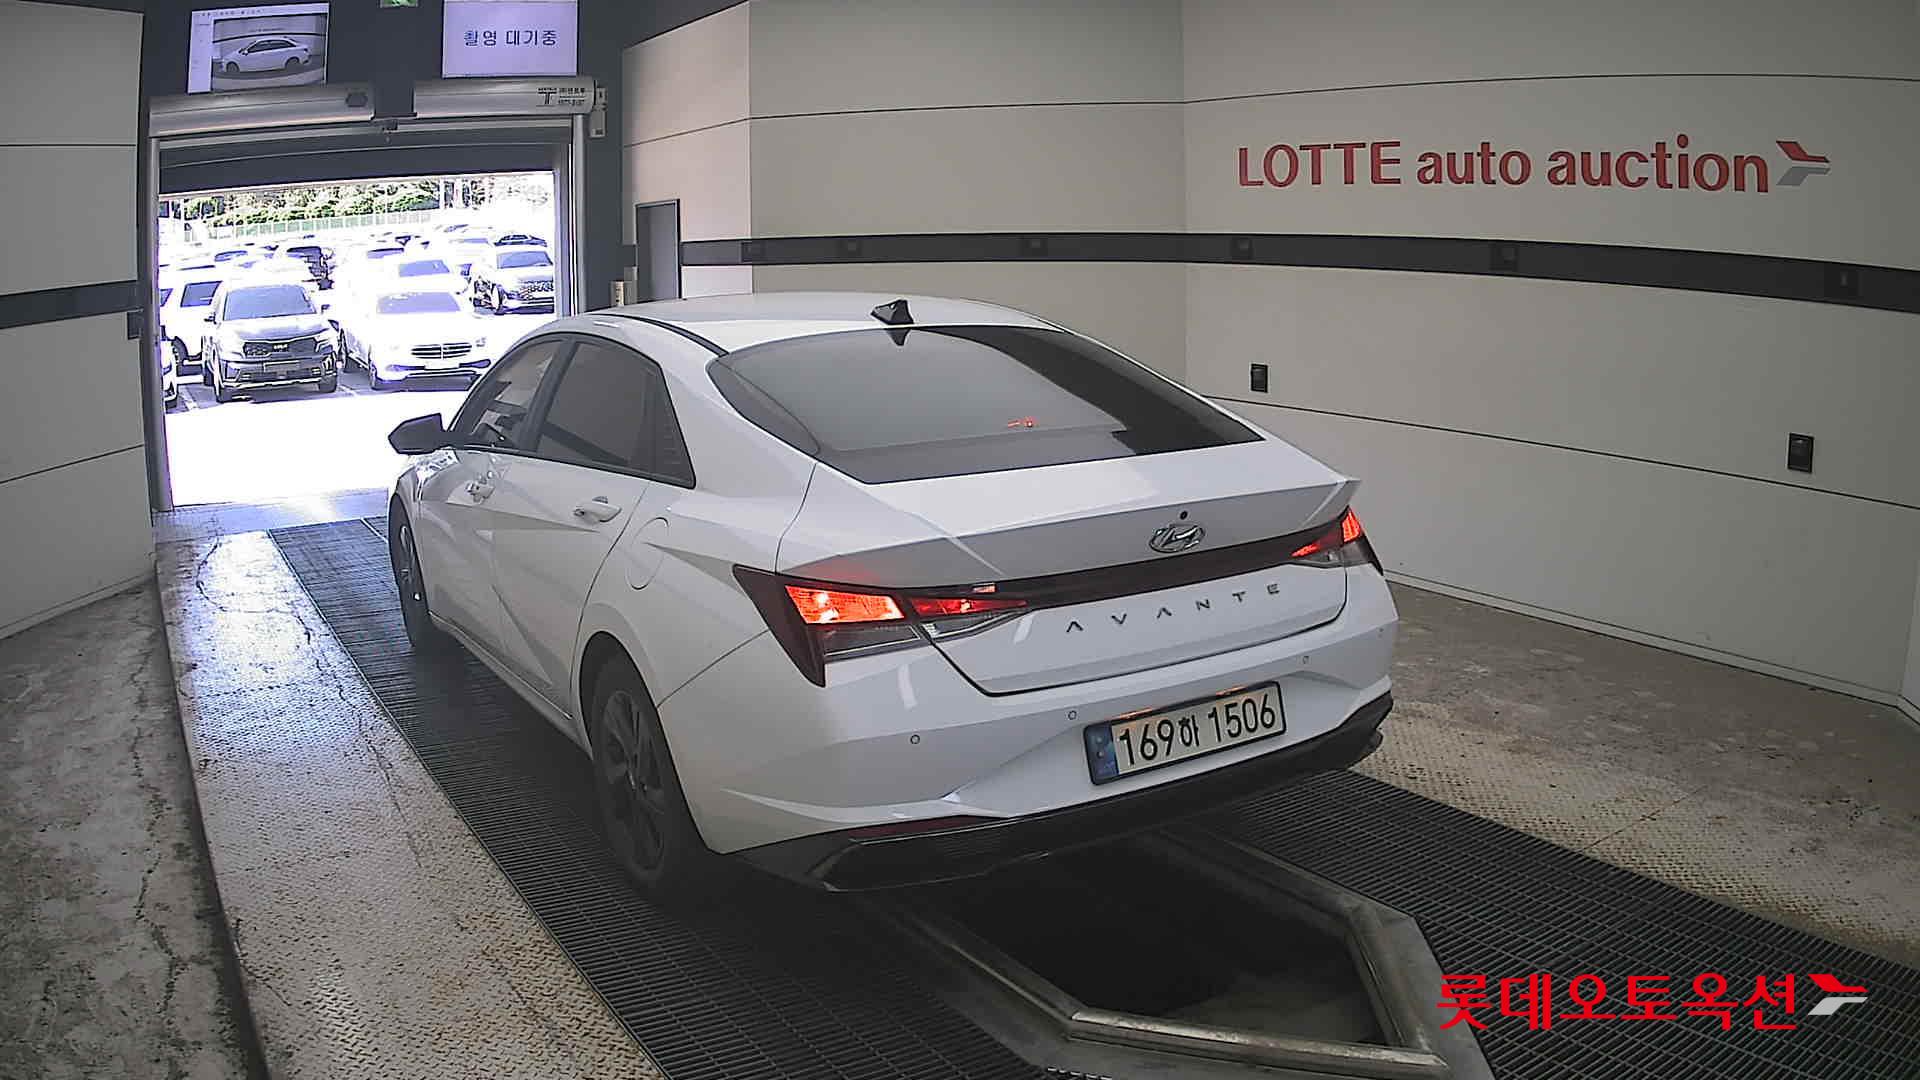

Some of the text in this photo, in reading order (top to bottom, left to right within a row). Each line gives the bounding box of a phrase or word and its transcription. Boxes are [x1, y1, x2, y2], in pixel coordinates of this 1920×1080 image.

[505, 29, 558, 46] 대기중
[1238, 133, 1769, 193] LOTTE auto auction
[1066, 583, 1280, 633] AVANTE
[1119, 693, 1276, 767] 169하 1506
